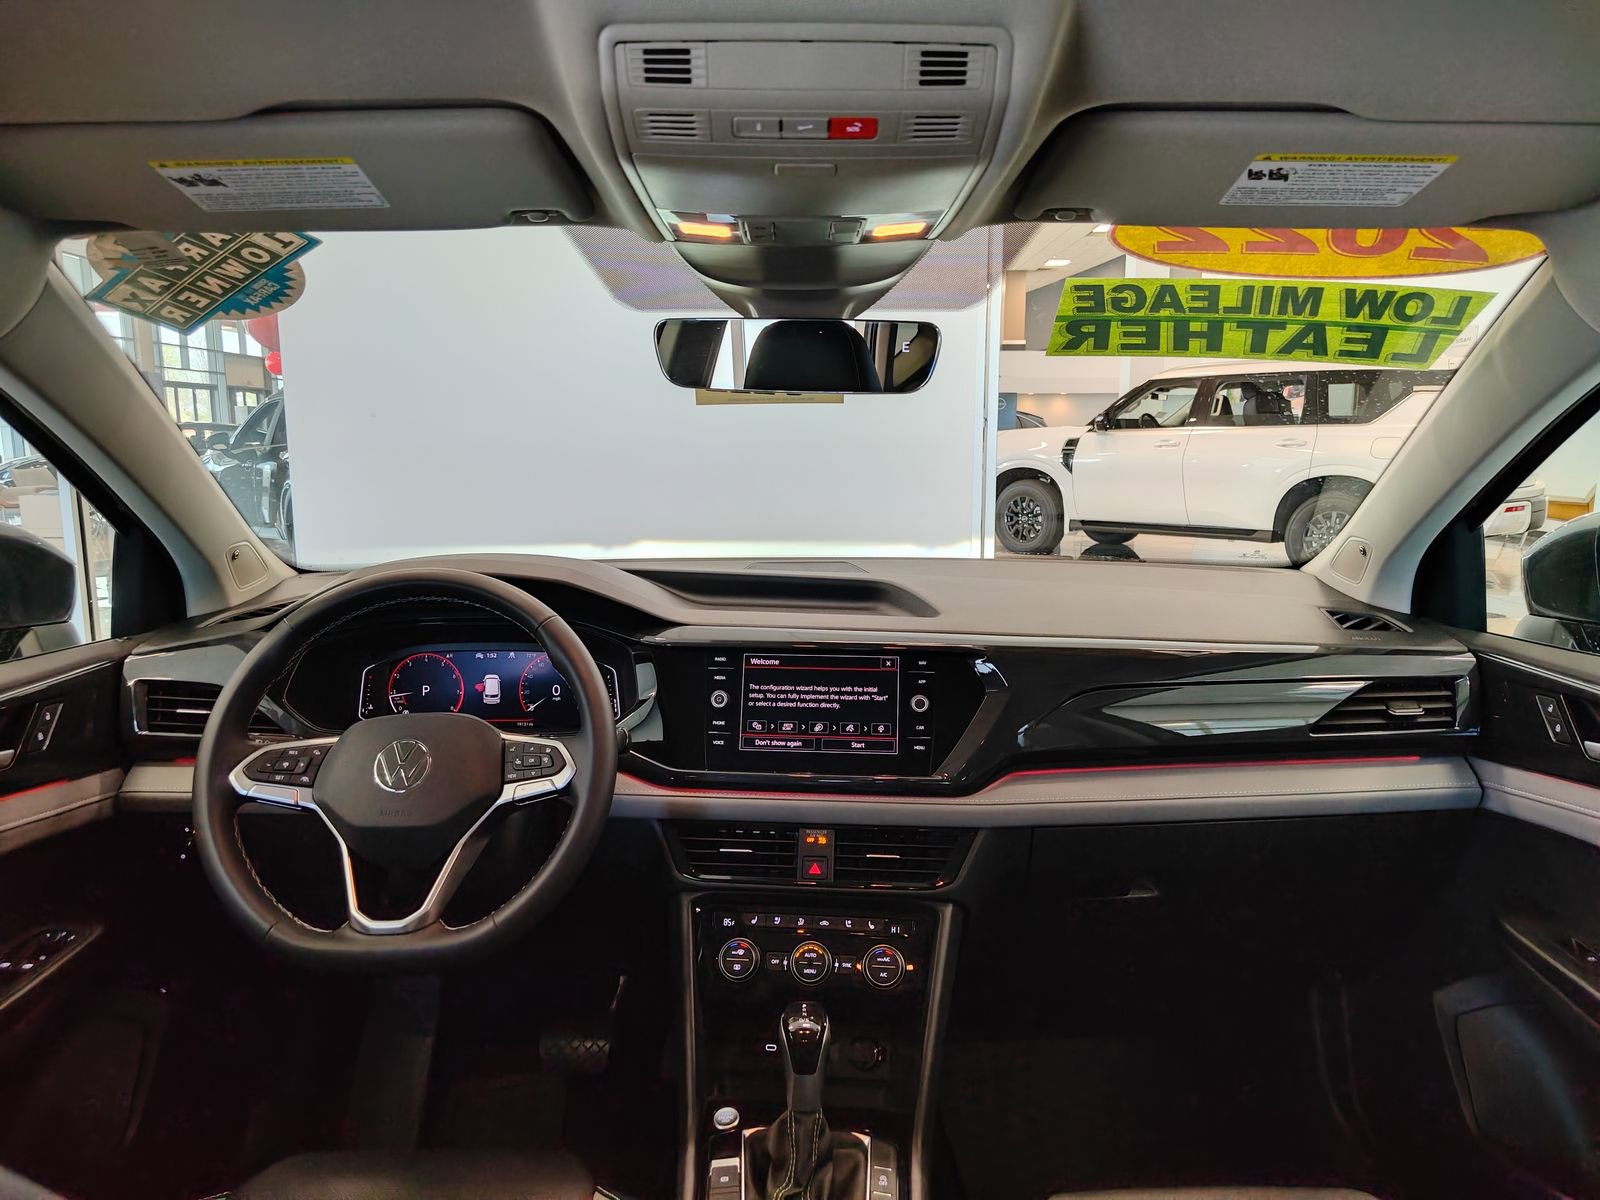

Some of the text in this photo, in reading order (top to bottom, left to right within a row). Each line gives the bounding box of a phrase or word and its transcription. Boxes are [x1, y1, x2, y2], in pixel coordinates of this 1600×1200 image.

[902, 341, 910, 353] E
[750, 658, 780, 666] Welcome
[422, 685, 431, 697] P
[552, 684, 561, 696] 0
[760, 684, 795, 692] configuration
[814, 685, 829, 693] helps
[748, 692, 765, 700] setup.
[788, 692, 799, 701] fully
[800, 693, 829, 701] implement
[871, 694, 889, 702] "Start"
[820, 702, 841, 710] directly.
[786, 740, 803, 748] again
[851, 741, 865, 749] Start
